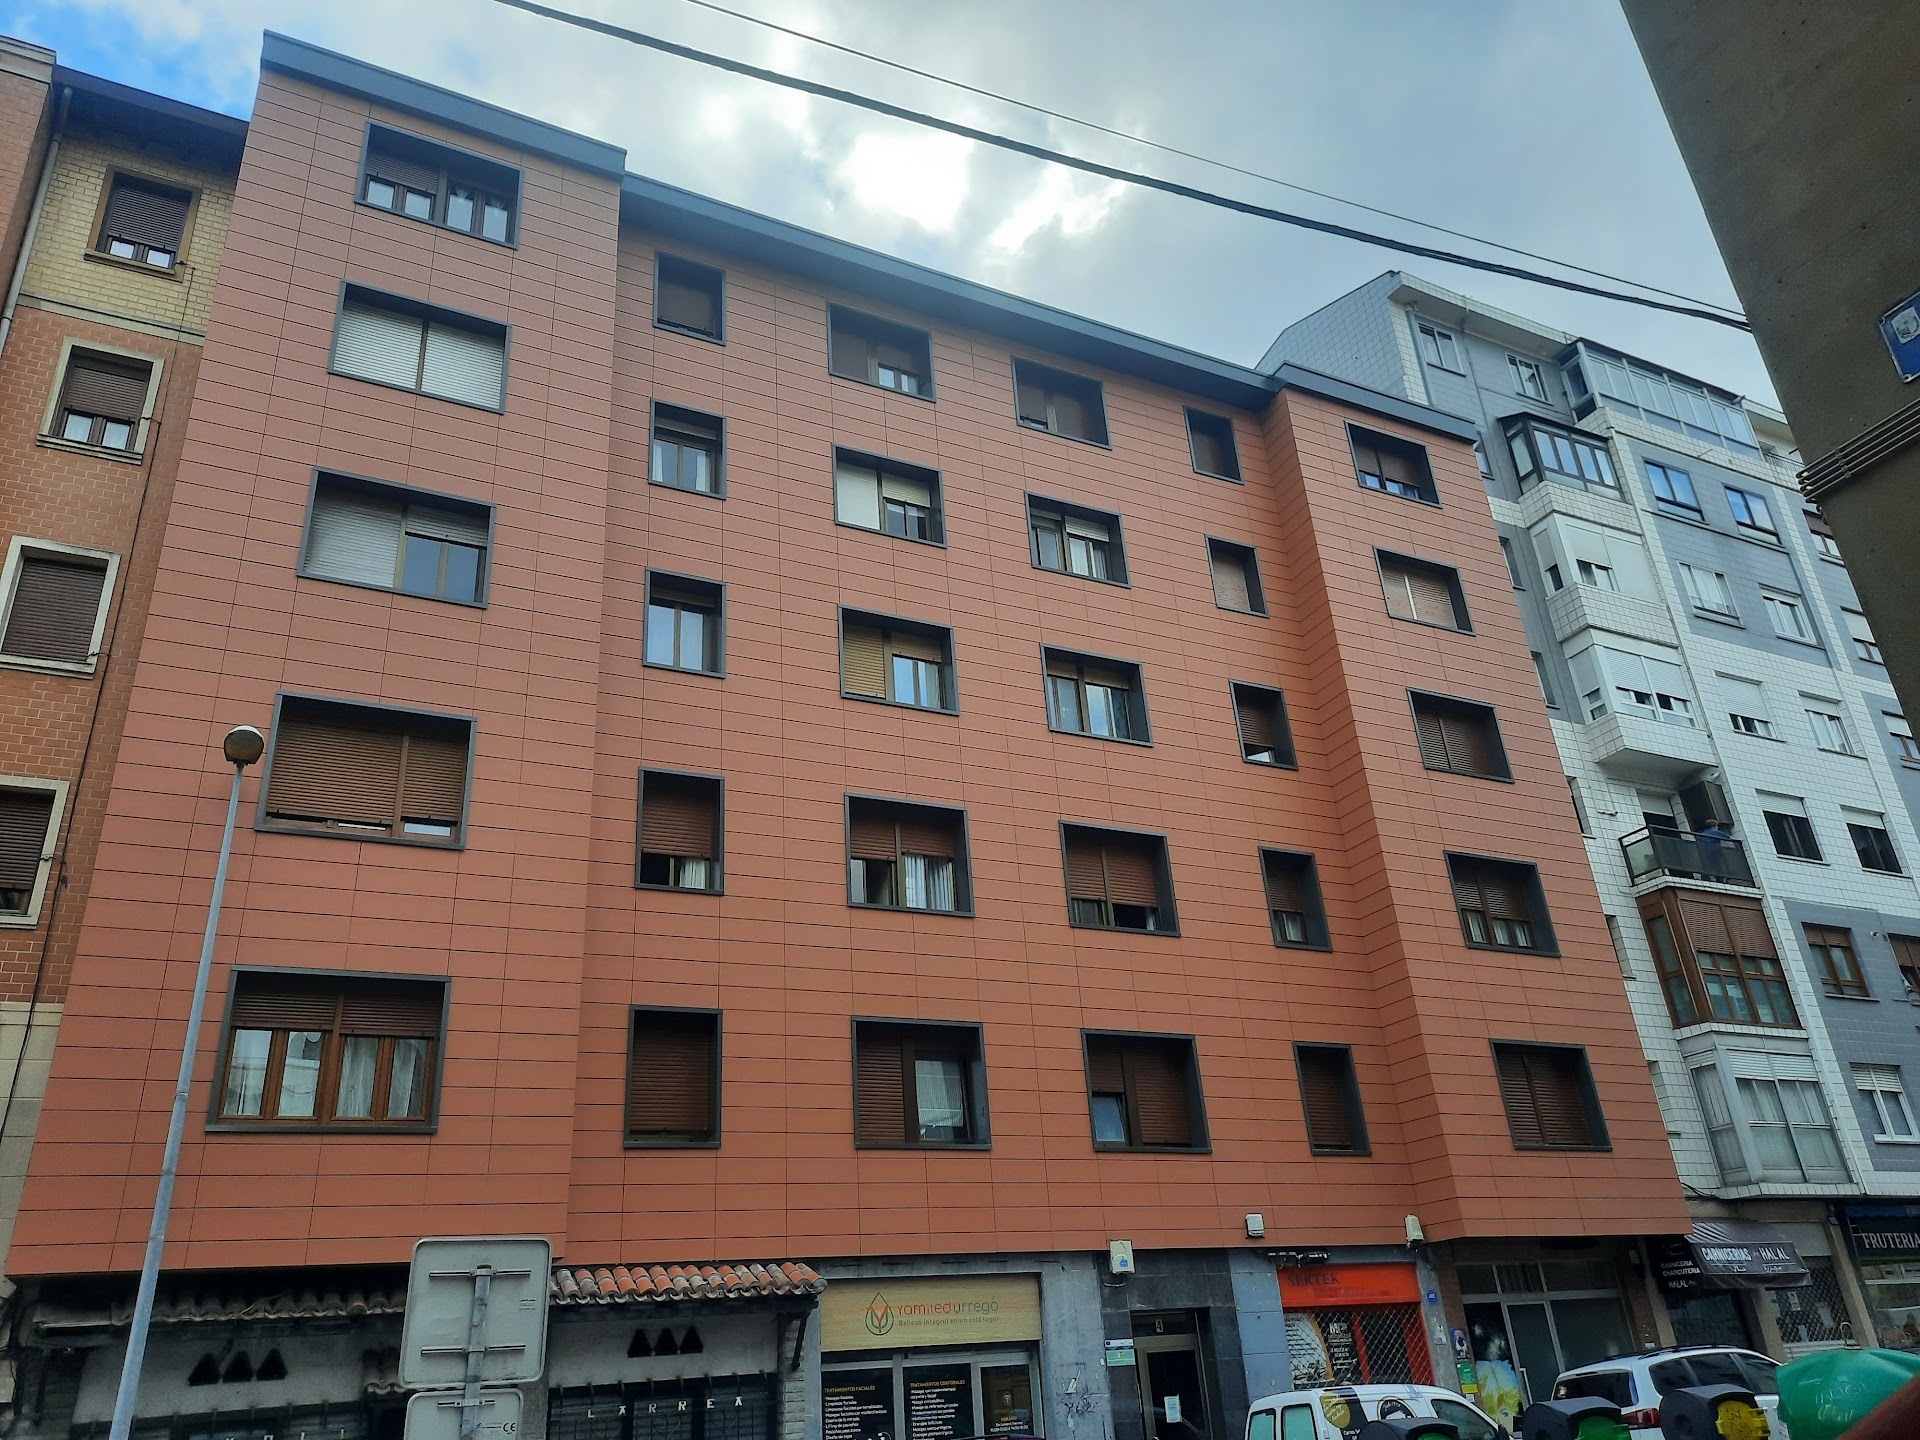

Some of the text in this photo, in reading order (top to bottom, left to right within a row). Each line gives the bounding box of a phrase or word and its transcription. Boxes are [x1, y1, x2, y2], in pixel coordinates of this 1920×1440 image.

[1861, 1232, 1920, 1249] FRUTERIA
[1701, 1247, 1752, 1261] CARNICERIAS
[1758, 1247, 1790, 1260] HALAL
[923, 1318, 949, 1326] integral
[587, 1396, 743, 1418] LARREA
